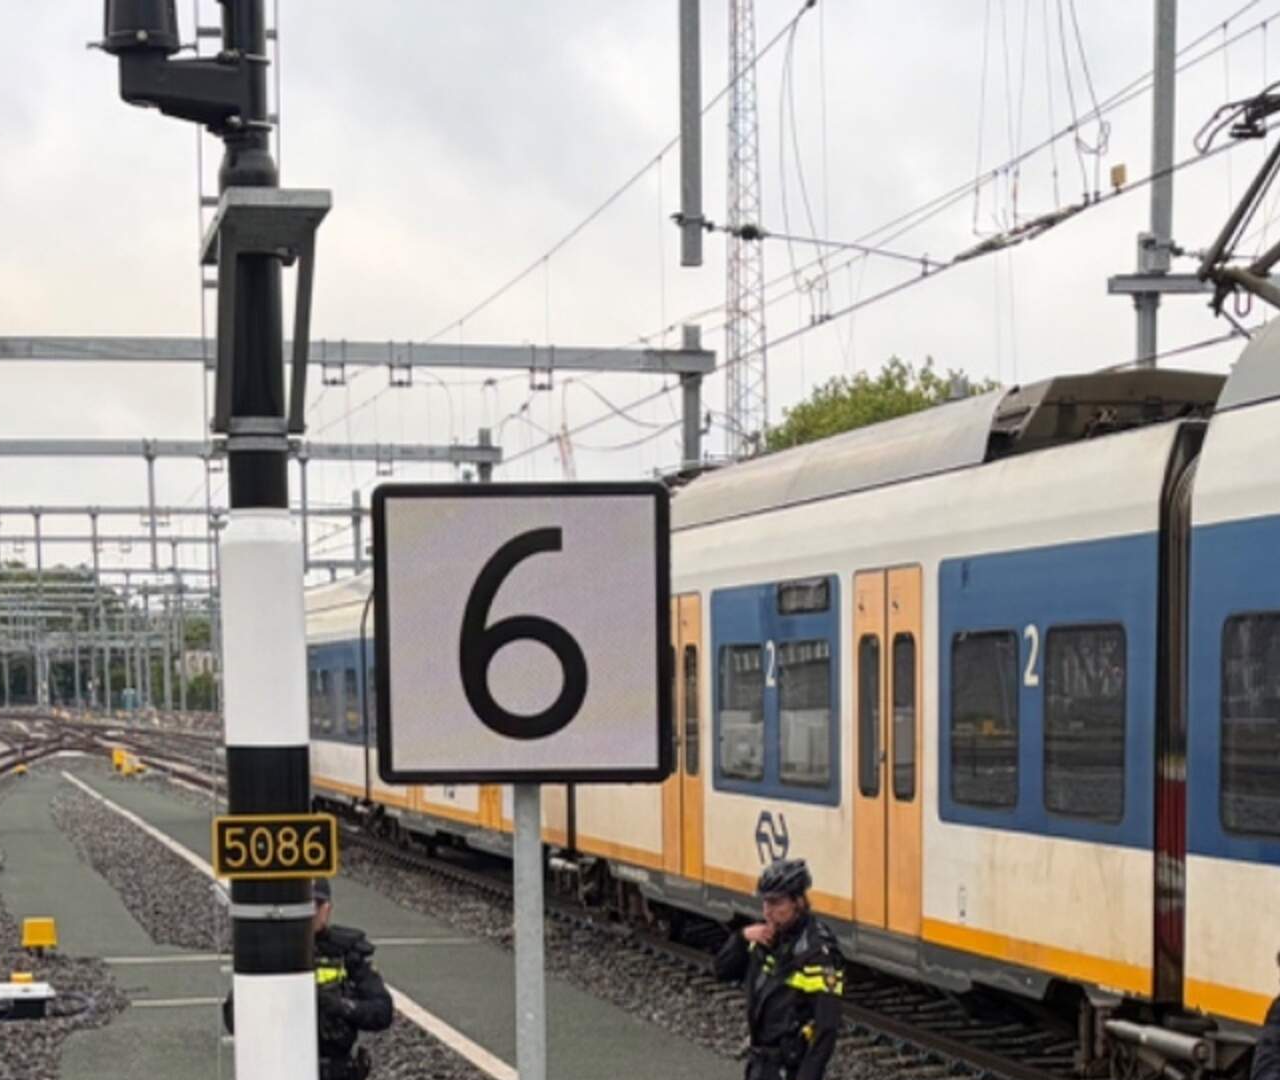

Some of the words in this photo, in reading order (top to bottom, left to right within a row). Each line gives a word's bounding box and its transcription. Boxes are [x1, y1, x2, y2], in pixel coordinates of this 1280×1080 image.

[460, 526, 588, 740] 6
[1023, 623, 1040, 687] 2
[765, 639, 776, 688] 2
[224, 826, 326, 868] 5086
